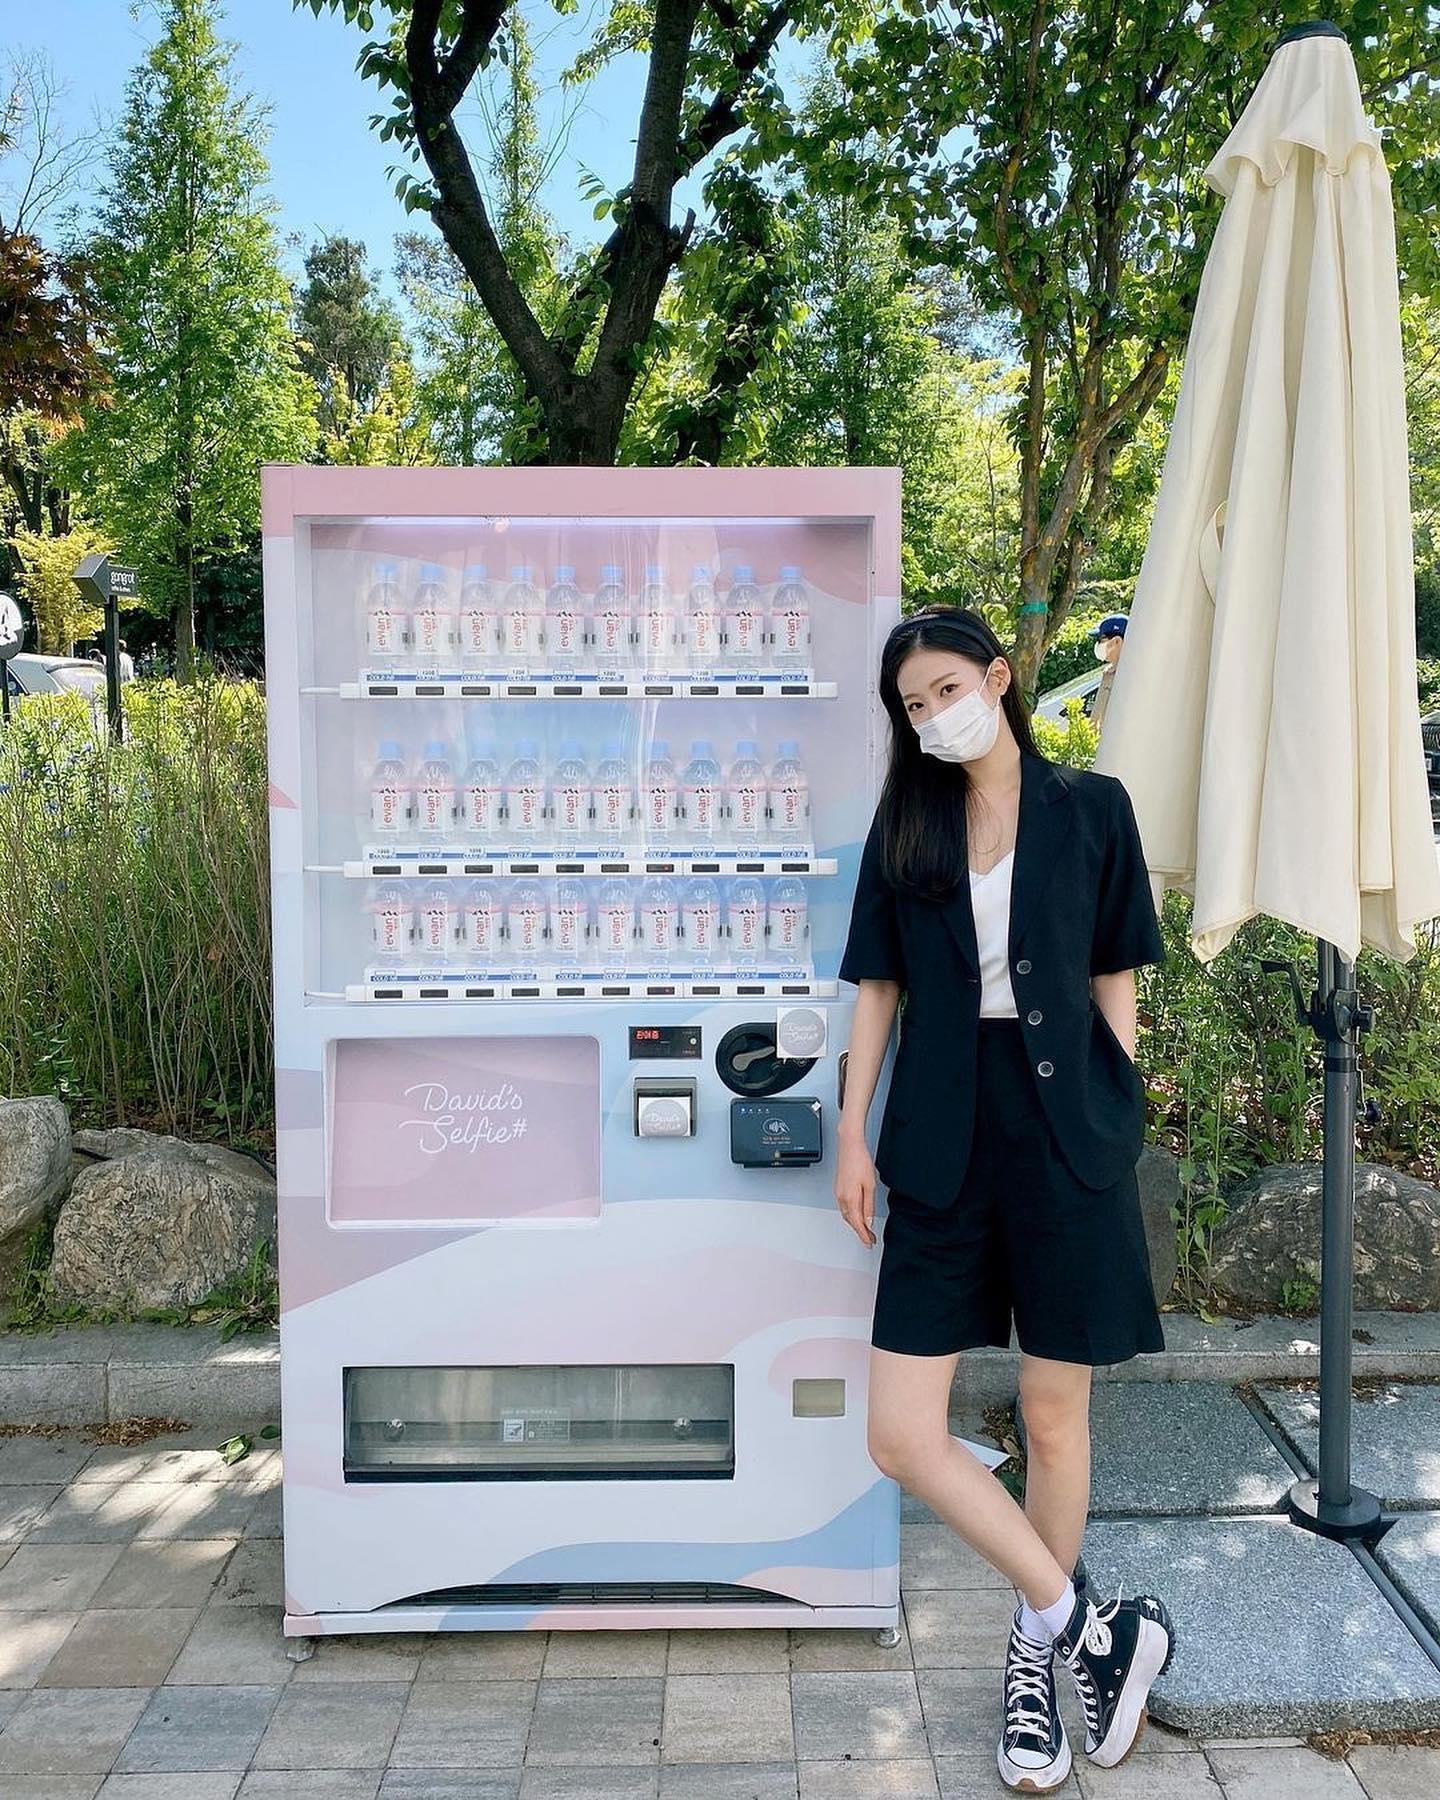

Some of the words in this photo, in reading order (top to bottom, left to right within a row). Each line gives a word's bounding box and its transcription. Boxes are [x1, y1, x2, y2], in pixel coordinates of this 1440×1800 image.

[377, 617, 386, 647] evian
[423, 617, 432, 647] evian
[472, 617, 481, 647] evian
[513, 617, 522, 647] evian
[560, 618, 569, 648] evian
[606, 618, 615, 648] evian
[651, 618, 660, 648] evian
[697, 618, 706, 647] evian
[739, 618, 748, 647] evian
[787, 617, 796, 647] evian
[383, 795, 392, 824] evian
[427, 795, 436, 824] evian
[474, 795, 483, 824] evian
[522, 795, 532, 824] evian
[566, 795, 575, 824] evian
[607, 795, 616, 824] evian
[654, 795, 663, 824] evian
[698, 795, 707, 824] evian
[742, 795, 751, 824] evian
[785, 795, 794, 824] evian
[385, 917, 394, 946] evian
[431, 916, 440, 945] evian
[476, 916, 485, 946] evian
[523, 916, 532, 945] evian
[560, 916, 569, 945] evian
[612, 916, 621, 945] evian
[655, 916, 664, 945] evian
[696, 915, 705, 945] evian
[743, 915, 752, 944] evian
[783, 914, 792, 944] evian
[404, 1082, 523, 1112] David's
[398, 1114, 528, 1154] Selfie#
